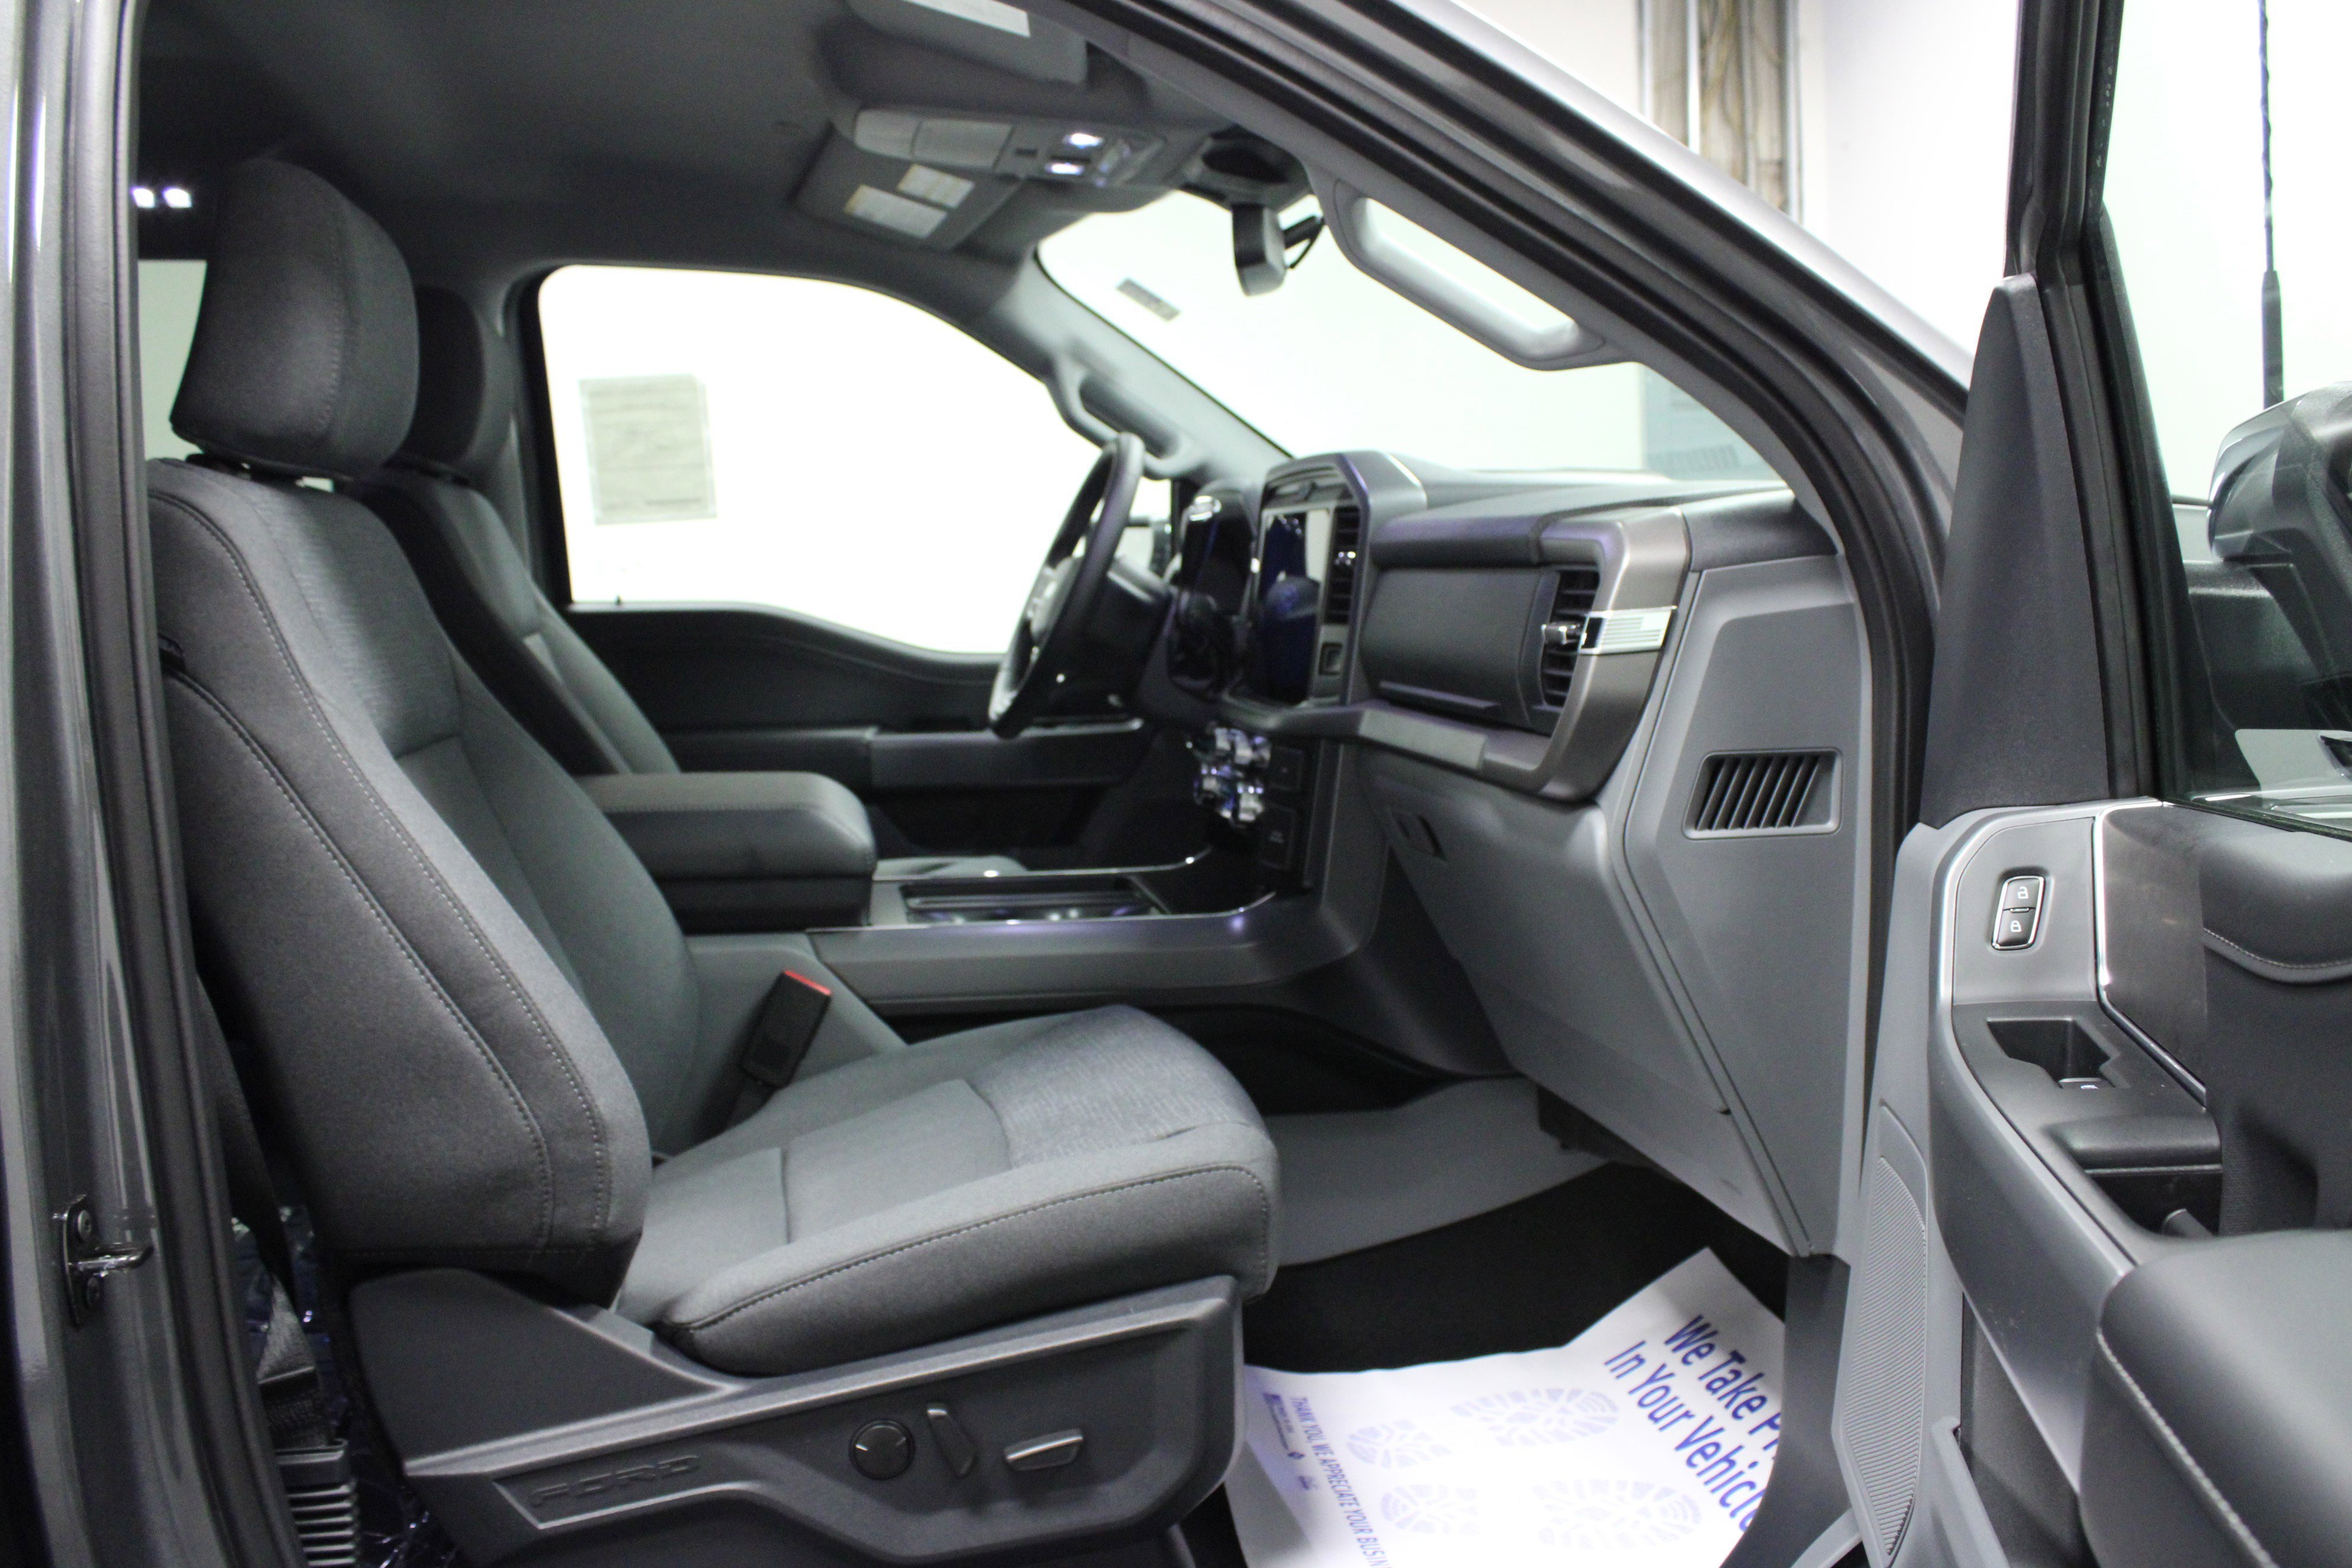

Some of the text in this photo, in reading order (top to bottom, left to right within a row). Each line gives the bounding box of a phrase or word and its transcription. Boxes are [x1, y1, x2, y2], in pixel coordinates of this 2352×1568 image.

[1603, 1340, 1647, 1380] In
[1627, 1363, 1696, 1432] Your
[1664, 1314, 1719, 1366] We
[1697, 1349, 1768, 1421] Take
[1311, 1444, 1335, 1456] WE
[534, 1455, 704, 1505] FORD
[1318, 1459, 1360, 1508] APPRECIATE
[1342, 1509, 1374, 1535] YOUR
[1356, 1537, 1391, 1568] BUSIN
